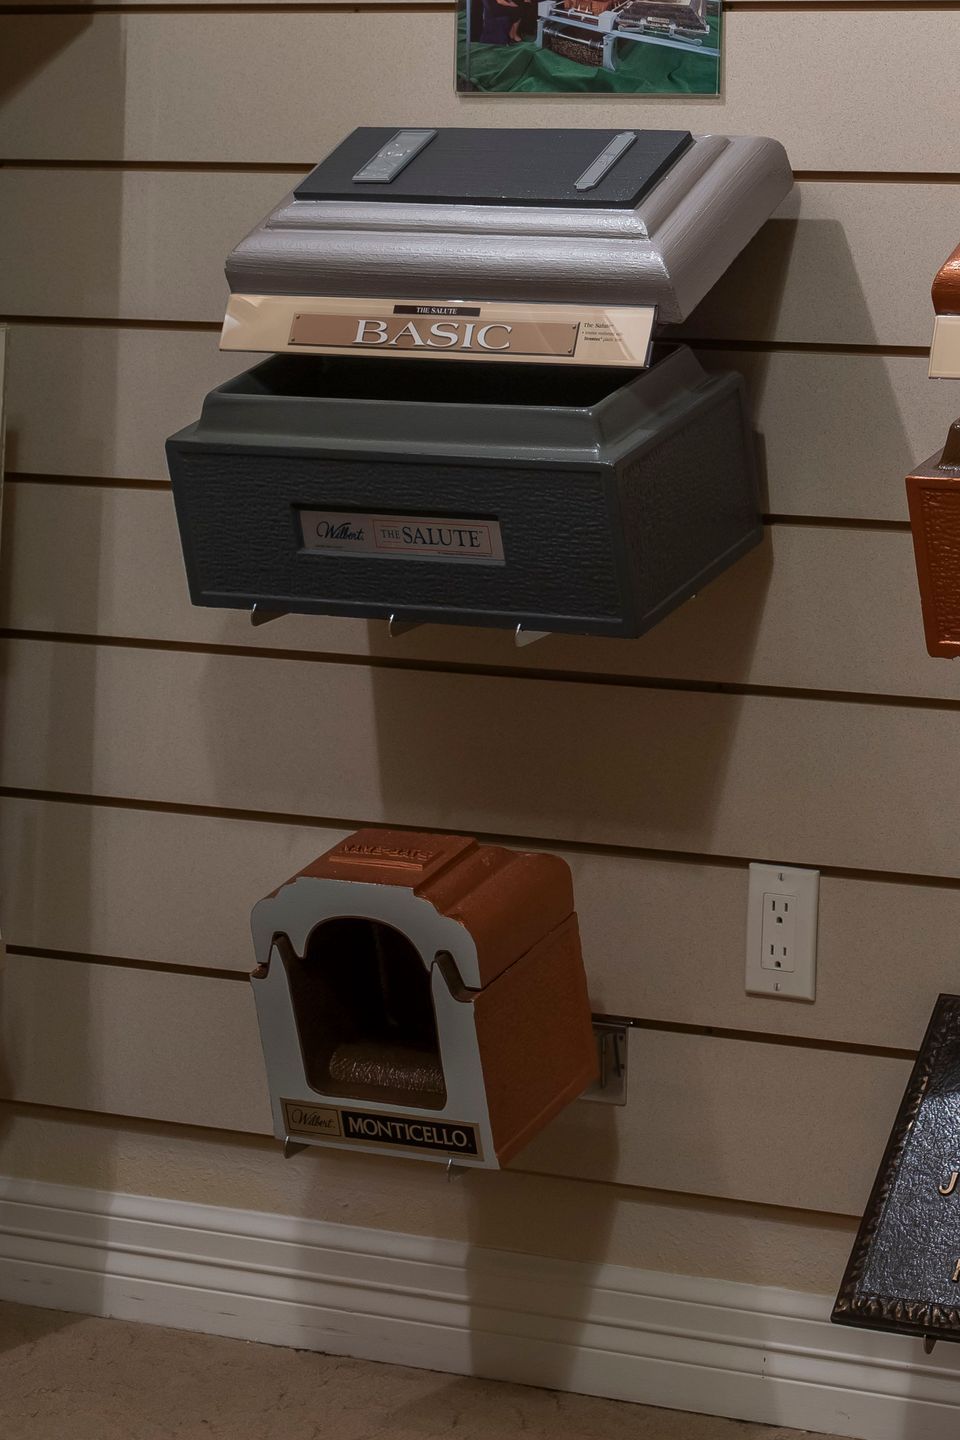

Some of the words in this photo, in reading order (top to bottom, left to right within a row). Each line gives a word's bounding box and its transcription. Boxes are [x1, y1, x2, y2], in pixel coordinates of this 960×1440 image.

[431, 307, 457, 315] SALUTE
[352, 319, 513, 350] BASIC
[316, 521, 364, 541] Wilbert
[381, 529, 400, 539] THE
[291, 1109, 335, 1129] Wilbert
[347, 1116, 468, 1147] MONTICELLO
